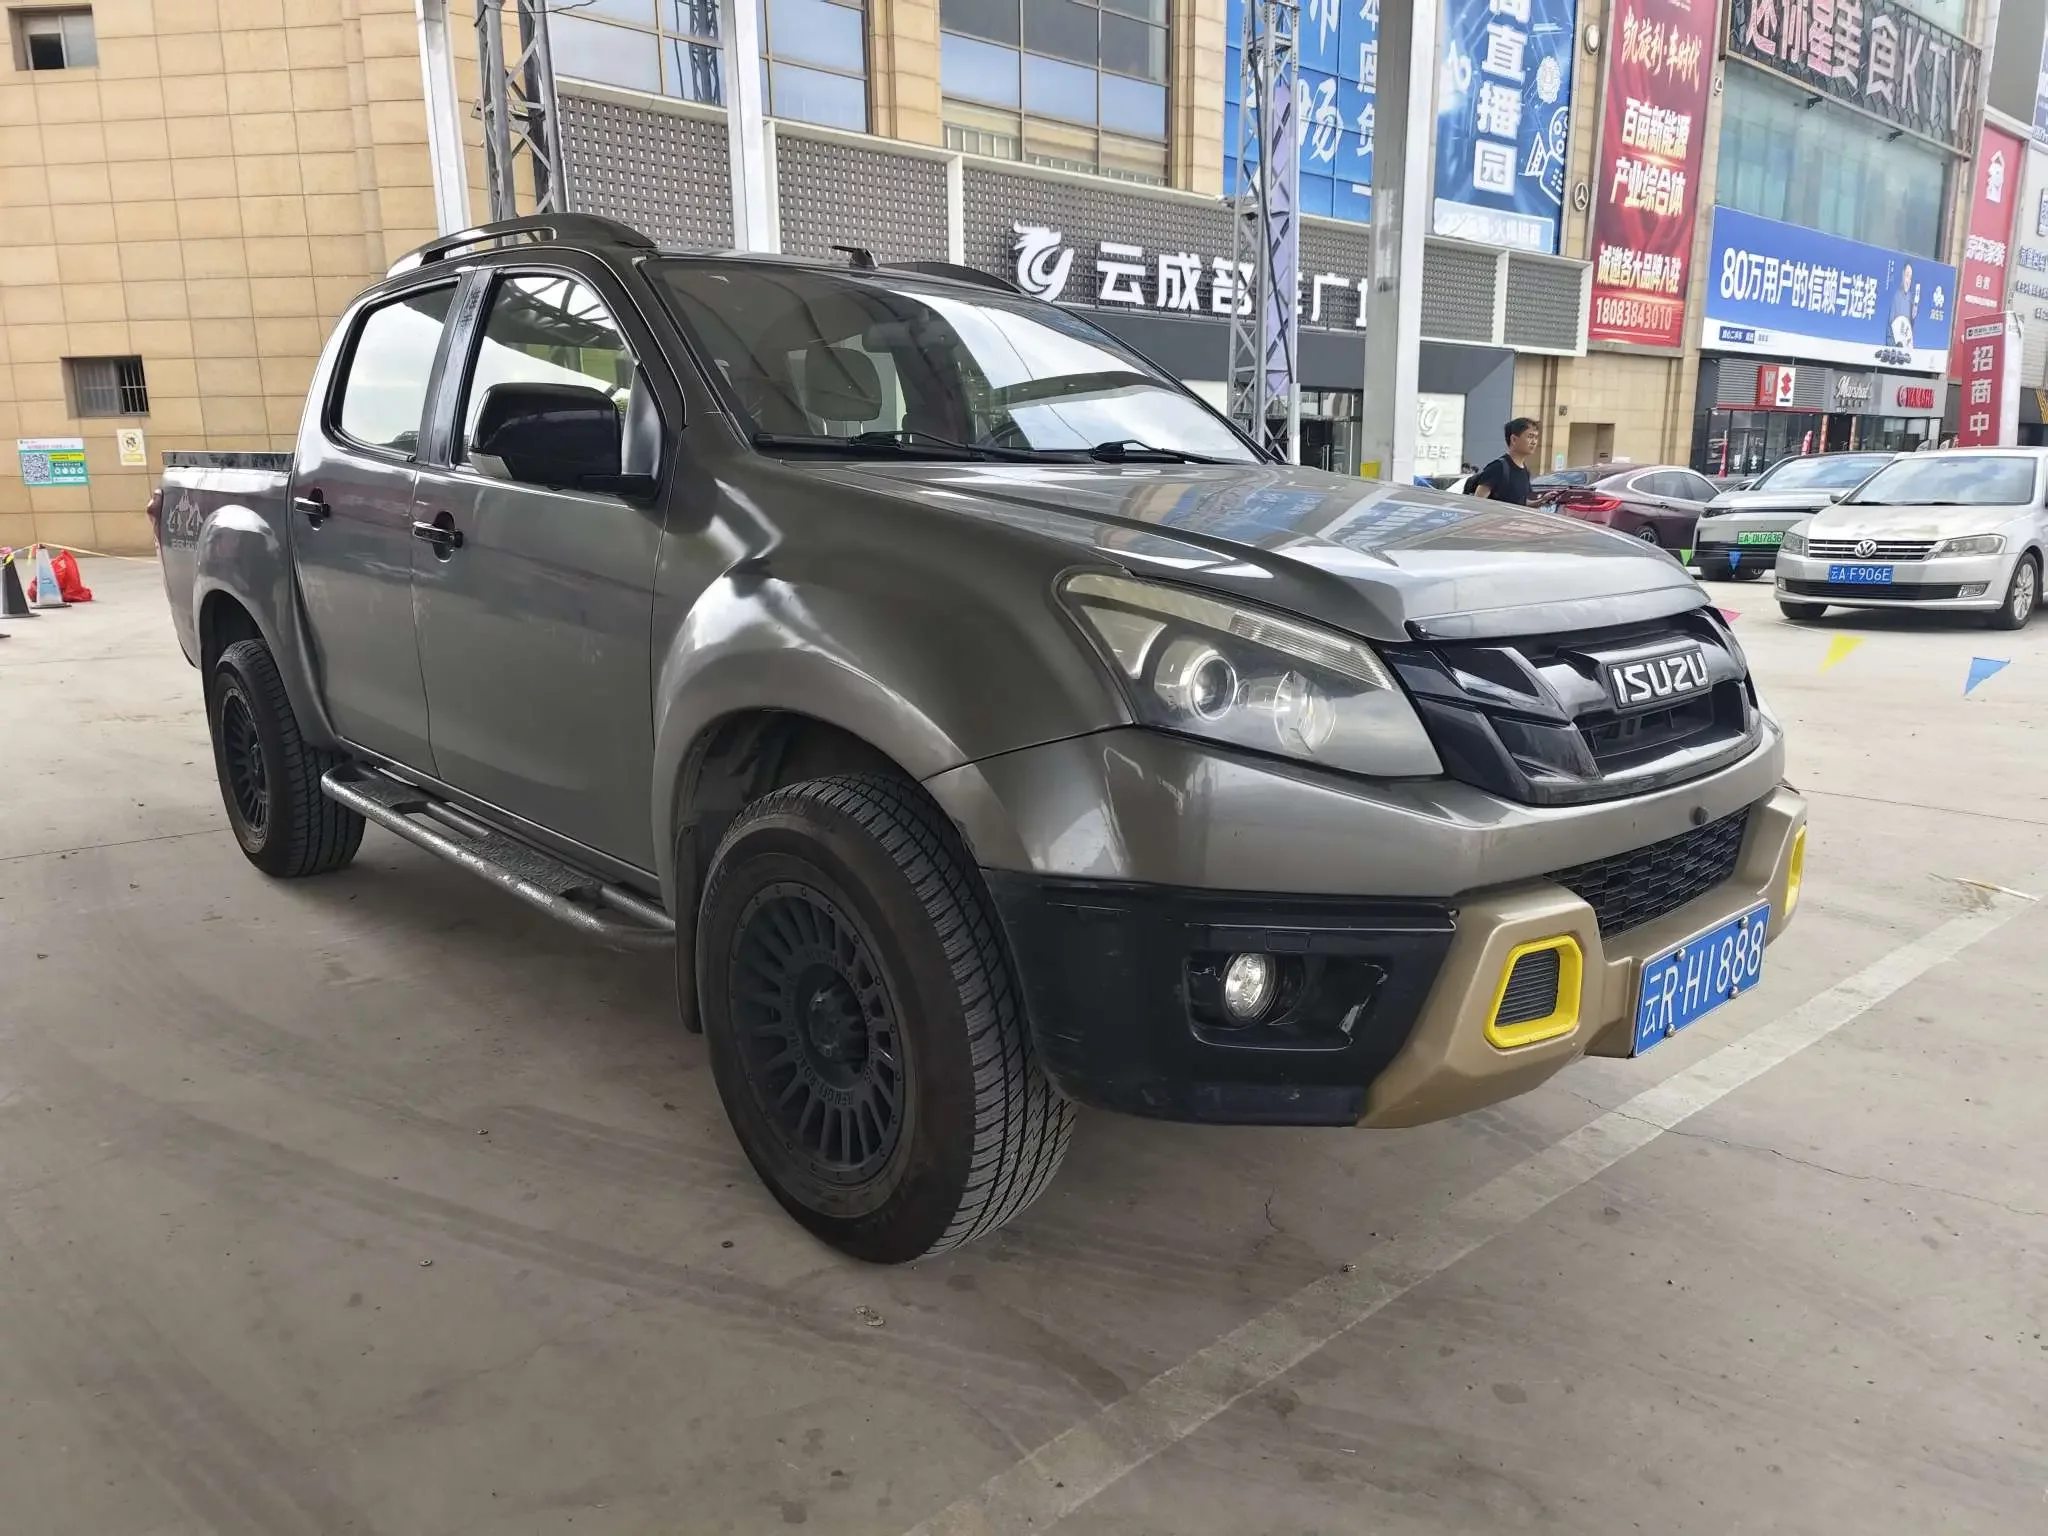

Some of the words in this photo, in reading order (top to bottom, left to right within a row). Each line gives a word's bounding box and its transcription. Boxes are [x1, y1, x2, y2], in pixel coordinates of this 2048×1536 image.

[1621, 96, 1692, 161] 百亩新能源
[1610, 156, 1687, 217] 产业综合体
[1596, 296, 1672, 331] 18083843010
[1720, 246, 1878, 321] 80万用户的信赖与选择
[1612, 652, 1709, 704] ISUZU
